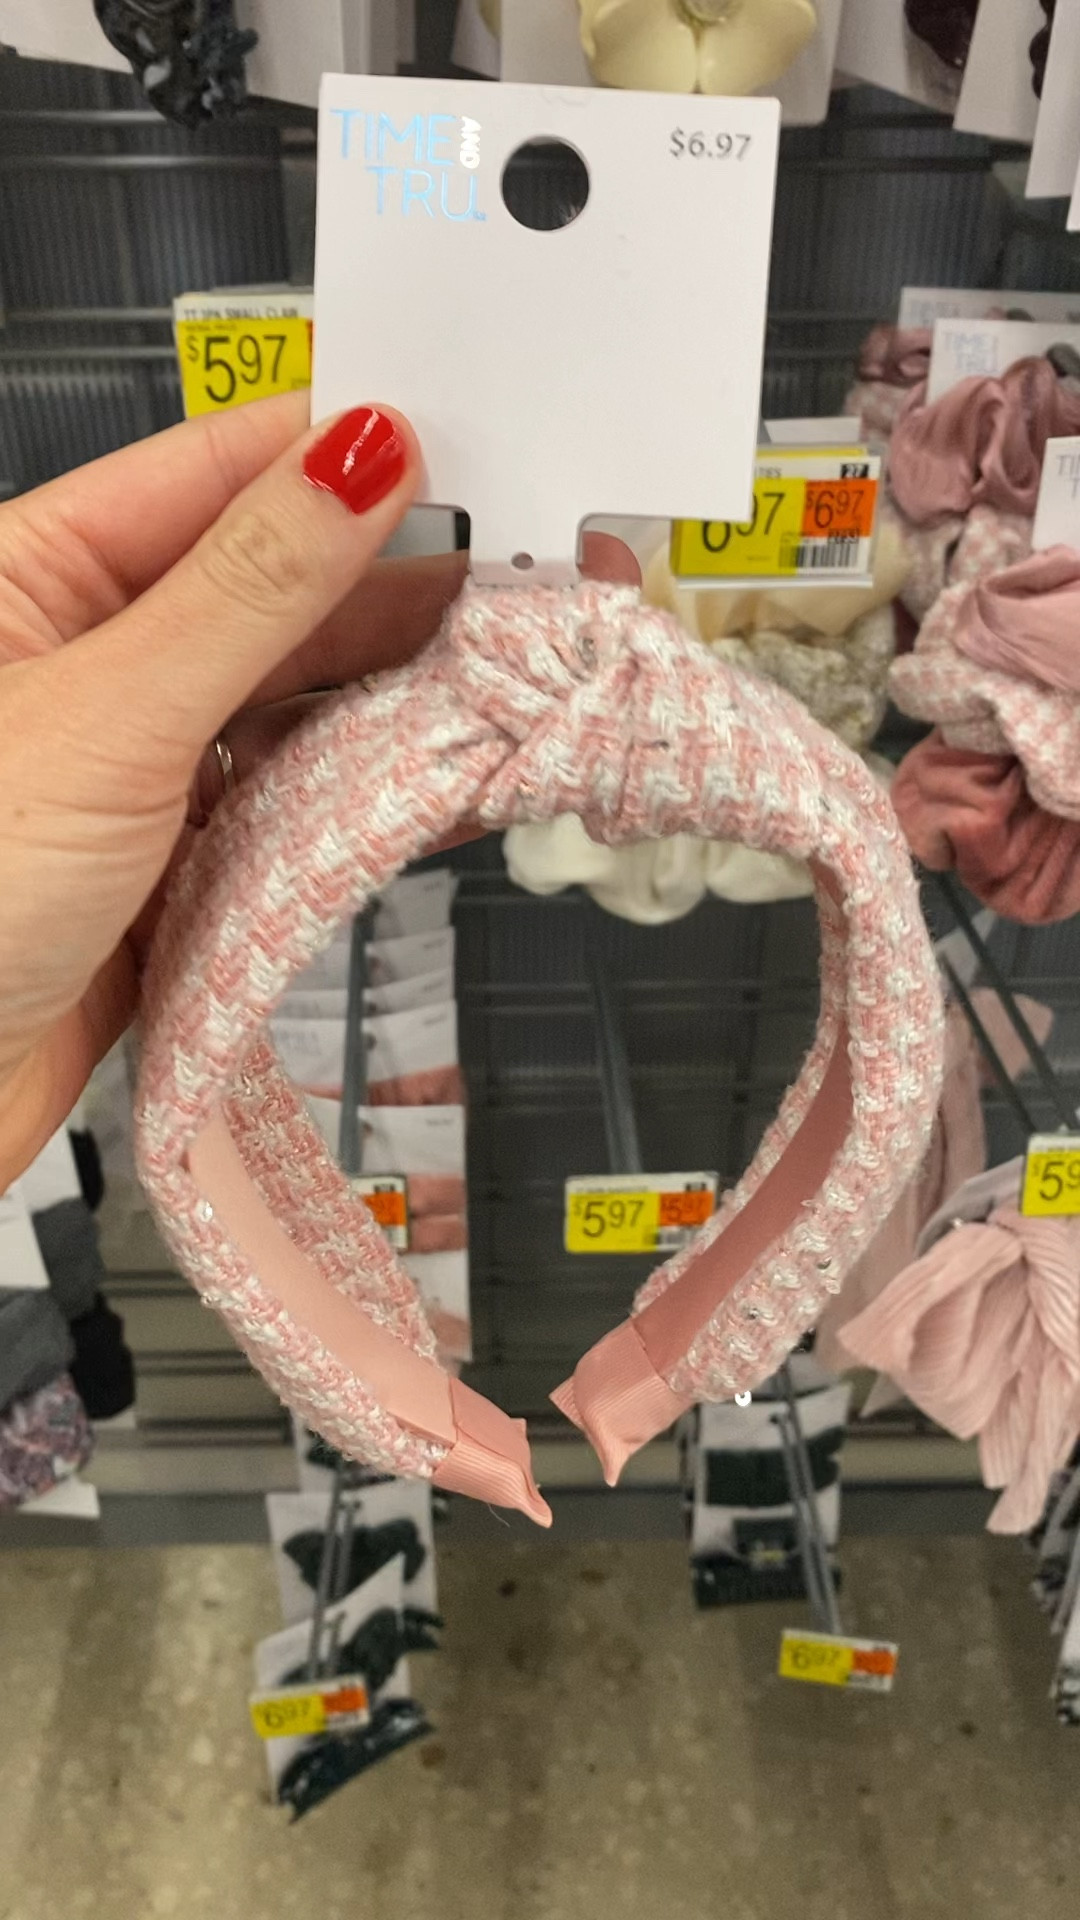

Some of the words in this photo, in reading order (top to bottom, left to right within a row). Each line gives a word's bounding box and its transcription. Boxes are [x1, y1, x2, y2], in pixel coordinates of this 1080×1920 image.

[330, 109, 457, 166] TIME
[459, 115, 482, 169] AND
[669, 126, 752, 161] $6.97
[365, 165, 477, 222] TRU
